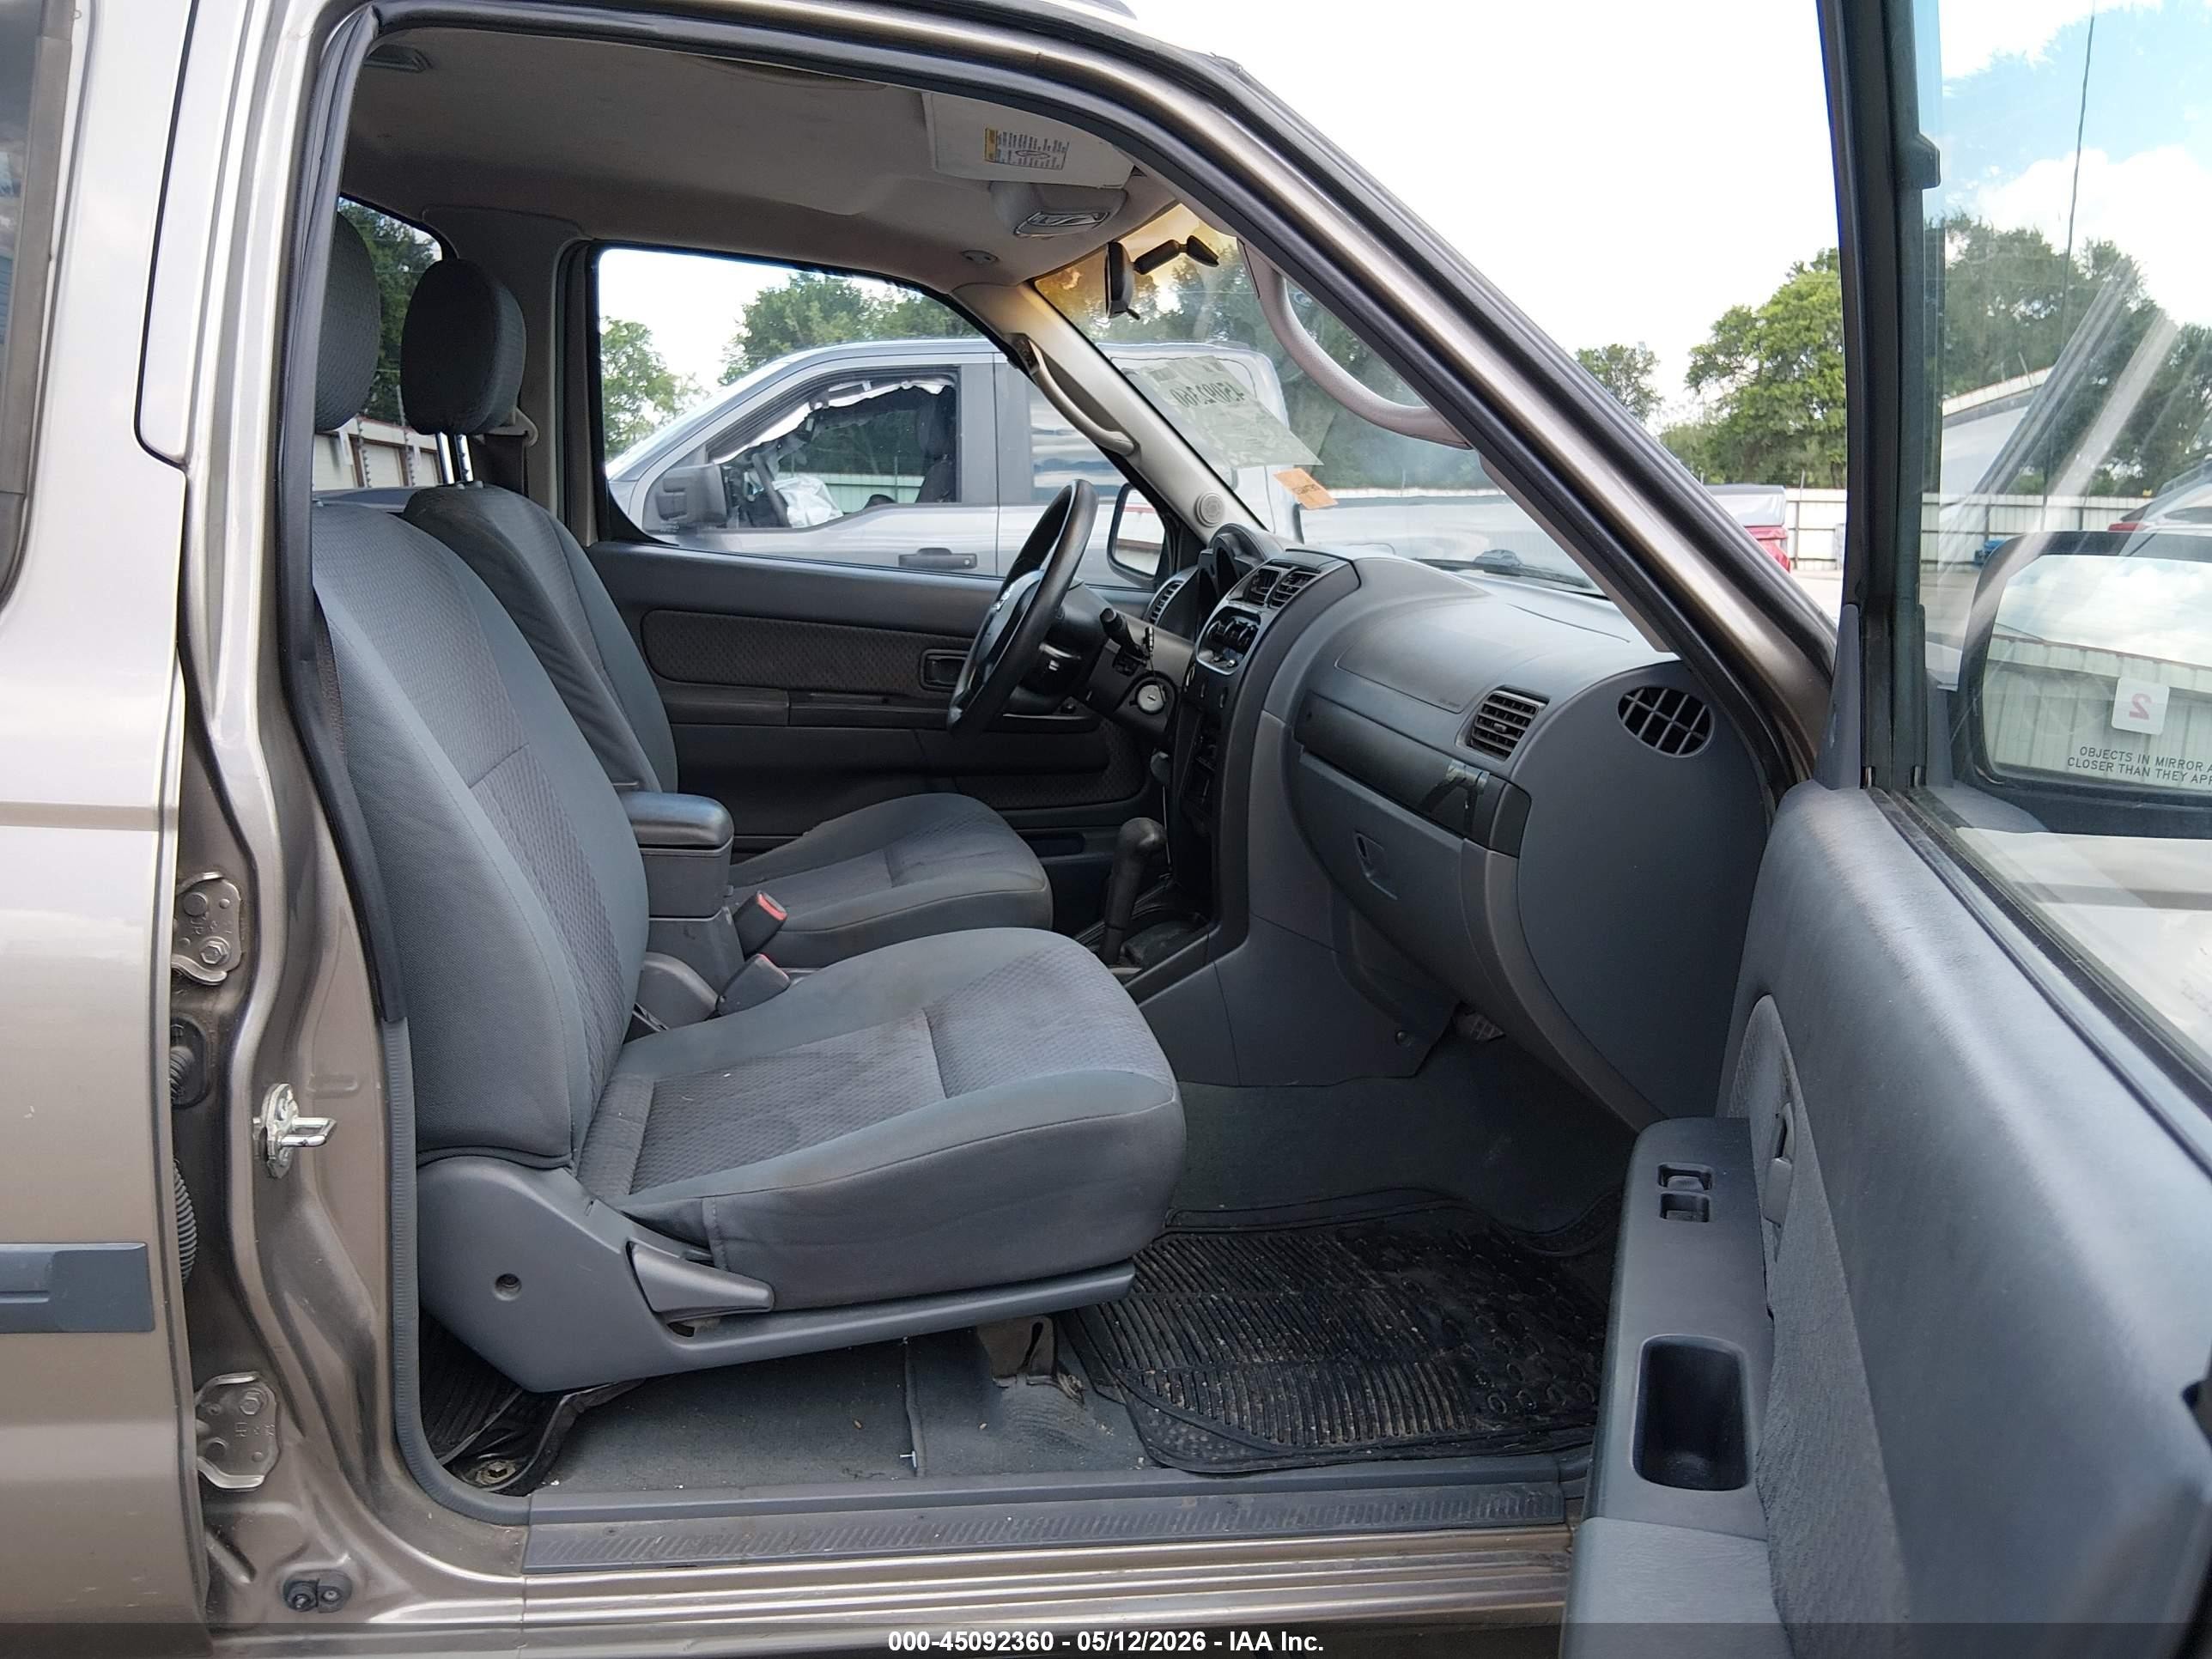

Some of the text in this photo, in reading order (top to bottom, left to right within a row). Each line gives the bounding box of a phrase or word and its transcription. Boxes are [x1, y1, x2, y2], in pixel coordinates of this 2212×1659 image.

[2067, 757, 2114, 772] CLOSER
[2118, 763, 2150, 776] THAN
[2155, 769, 2188, 781] THEY
[2080, 746, 2133, 763] OBJECTS
[2137, 754, 2150, 764] IN
[2155, 757, 2203, 772] MIRROR
